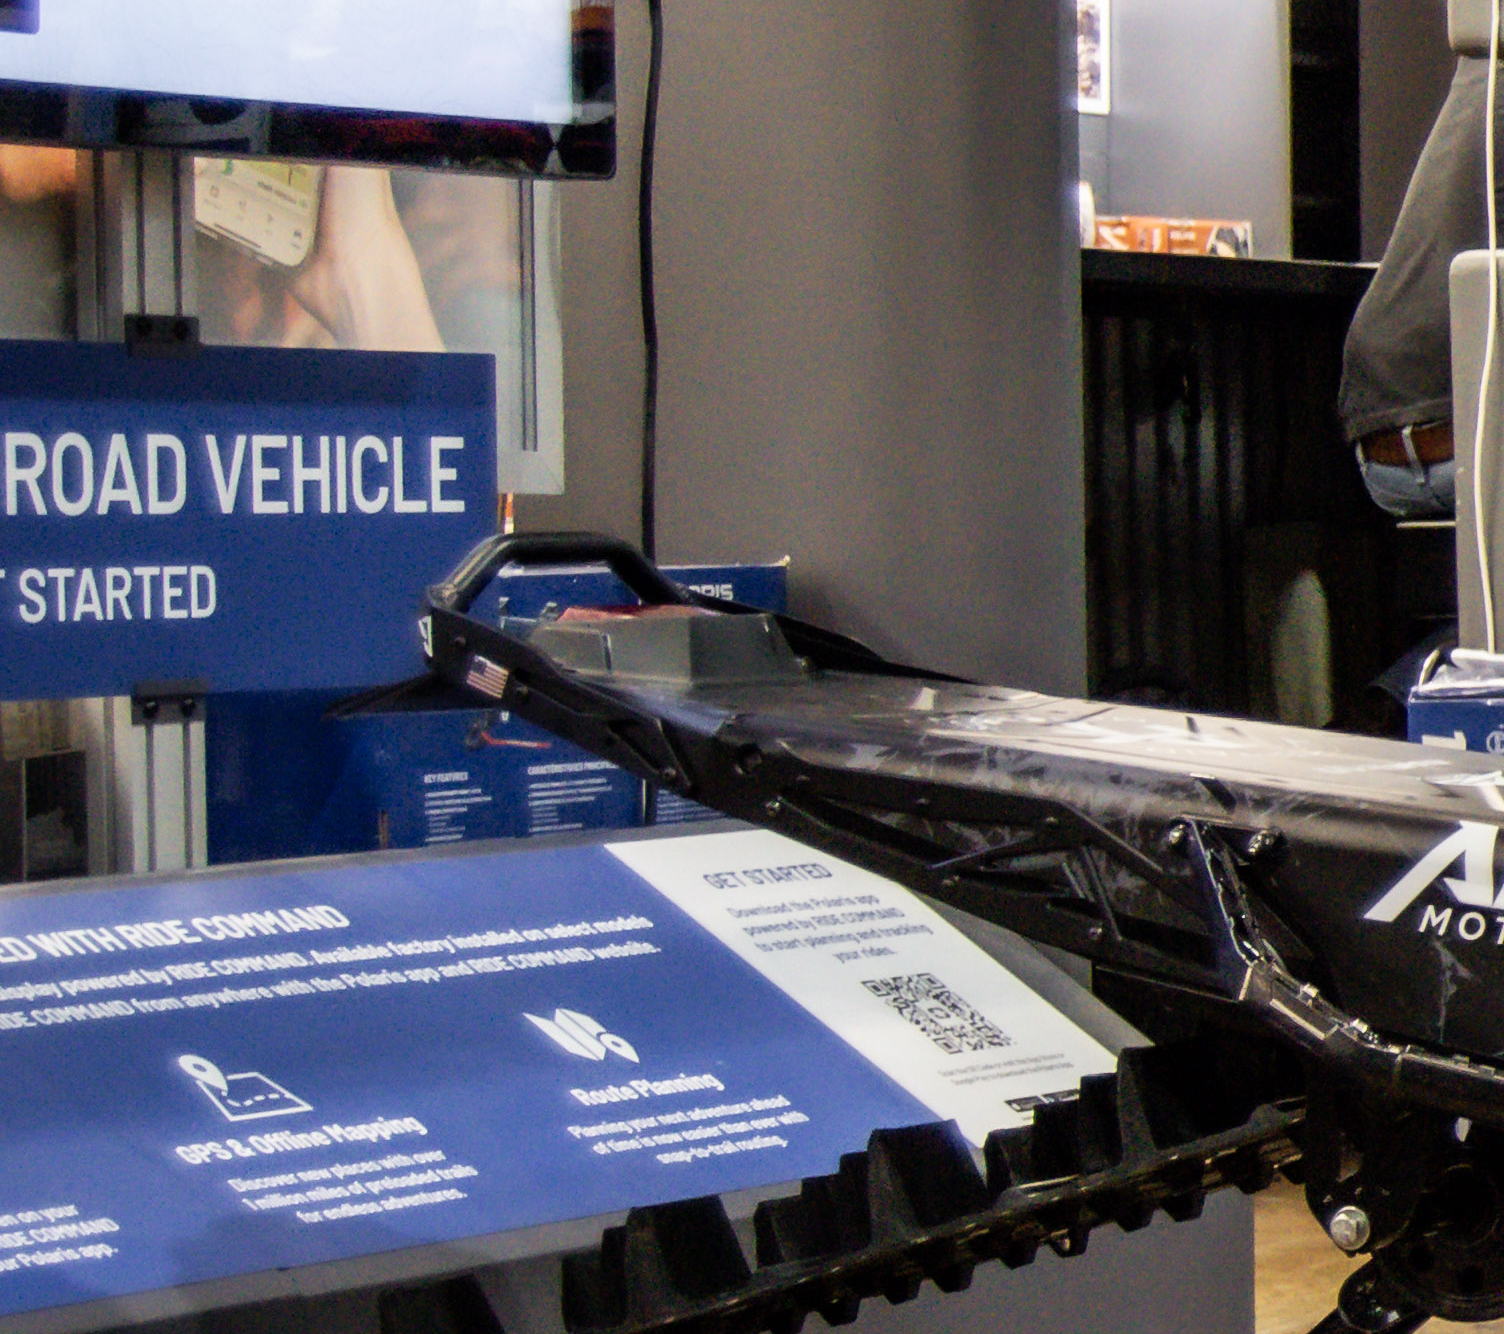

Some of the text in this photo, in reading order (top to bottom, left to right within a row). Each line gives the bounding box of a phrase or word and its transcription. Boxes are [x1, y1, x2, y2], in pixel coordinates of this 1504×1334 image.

[3, 431, 466, 516] ROAD VEHICLE
[18, 561, 217, 623] STARTED
[703, 862, 833, 889] GET STARTED
[28, 927, 127, 958] WITH
[114, 919, 202, 949] RIDE
[191, 905, 350, 941] COMMAND
[31, 999, 135, 1026] COMMAND
[130, 997, 186, 1014] from
[181, 986, 274, 1009] anywhere
[506, 946, 596, 969] COMMAND
[59, 969, 148, 997] powered
[165, 961, 218, 981] RIDE
[569, 1072, 725, 1106] Route Planning
[174, 1116, 429, 1167] GPS & Offline Mapping
[0, 1230, 35, 1248] IDE
[29, 1217, 120, 1243] COMMAND
[16, 1247, 81, 1267] Polaris
